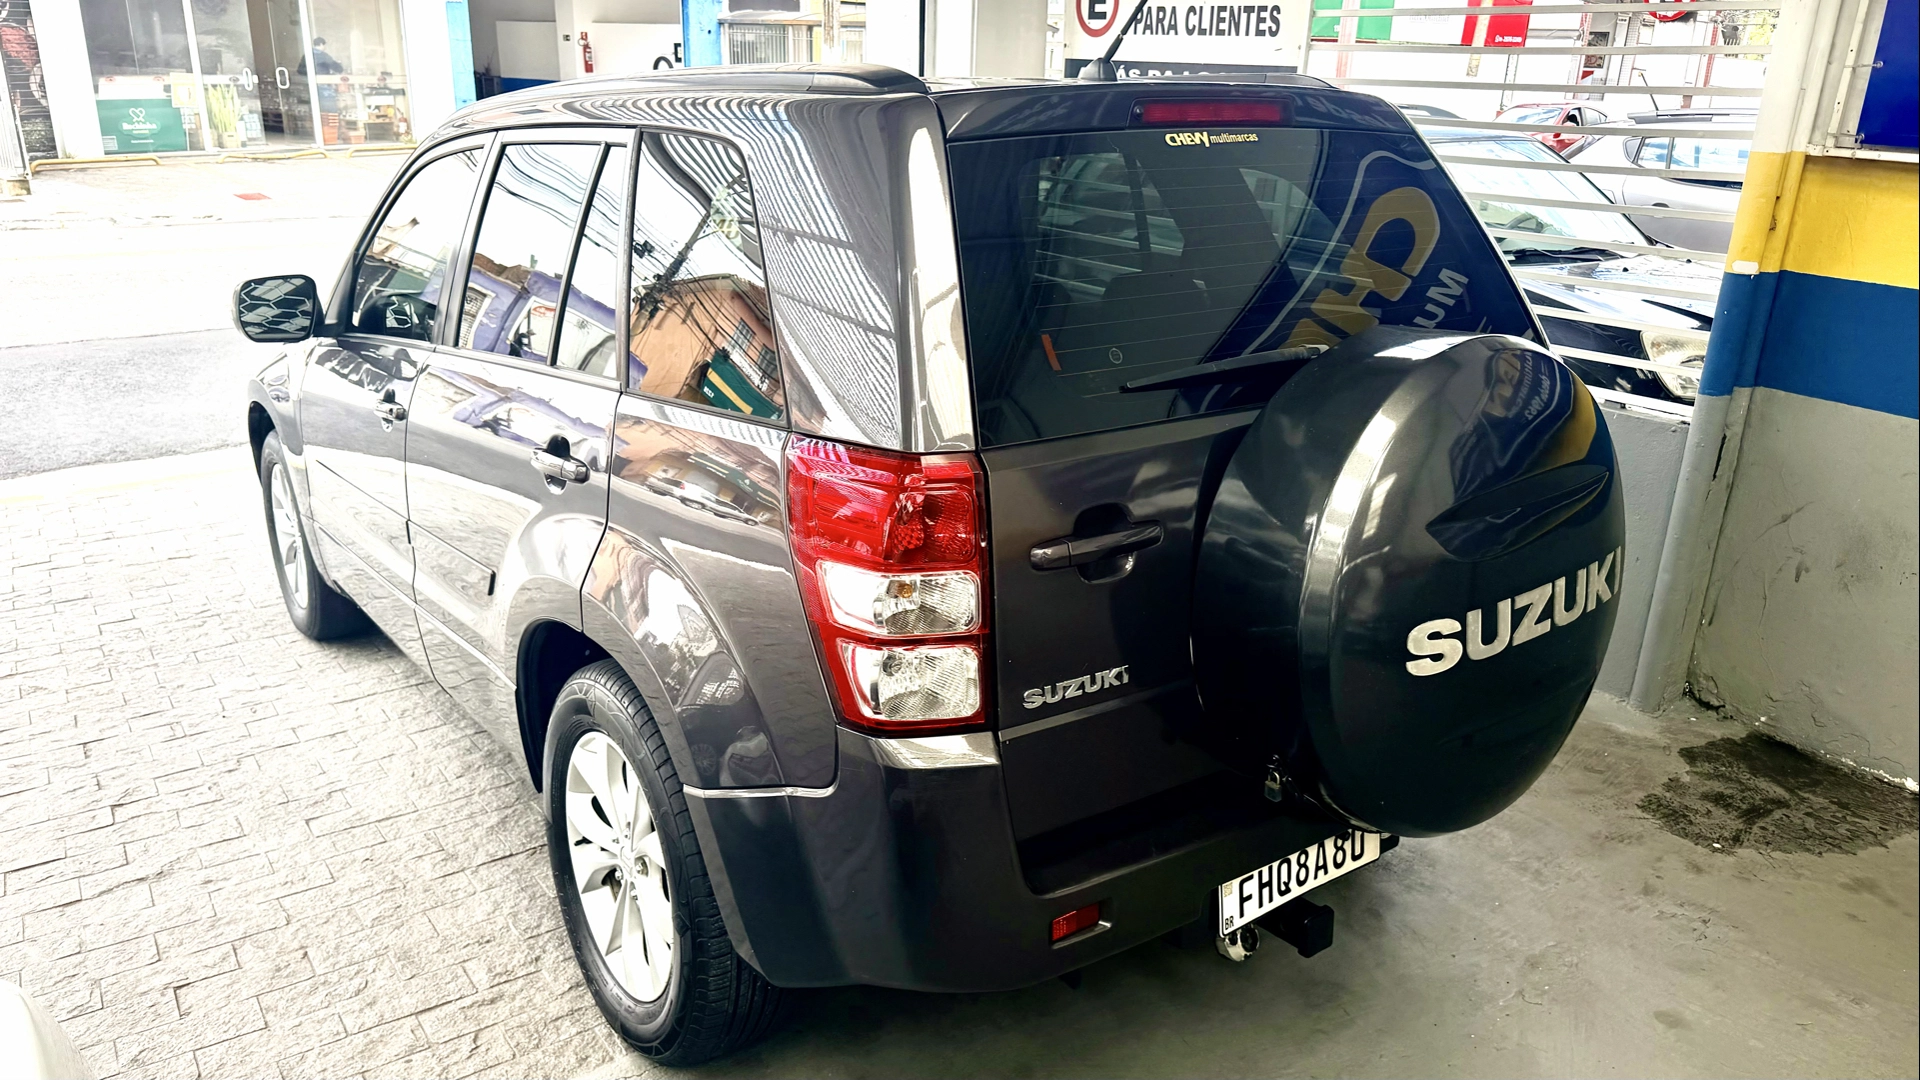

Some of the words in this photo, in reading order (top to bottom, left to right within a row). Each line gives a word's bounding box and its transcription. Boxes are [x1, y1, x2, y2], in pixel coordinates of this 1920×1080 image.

[1133, 6, 1179, 36] PARA
[1185, 5, 1282, 38] CLIENTES
[1165, 131, 1210, 148] CHEVY
[1210, 132, 1258, 144] multimarcas
[1405, 546, 1622, 676] SUZUKI
[1022, 665, 1129, 709] SUZUKI
[1225, 915, 1235, 931] BR
